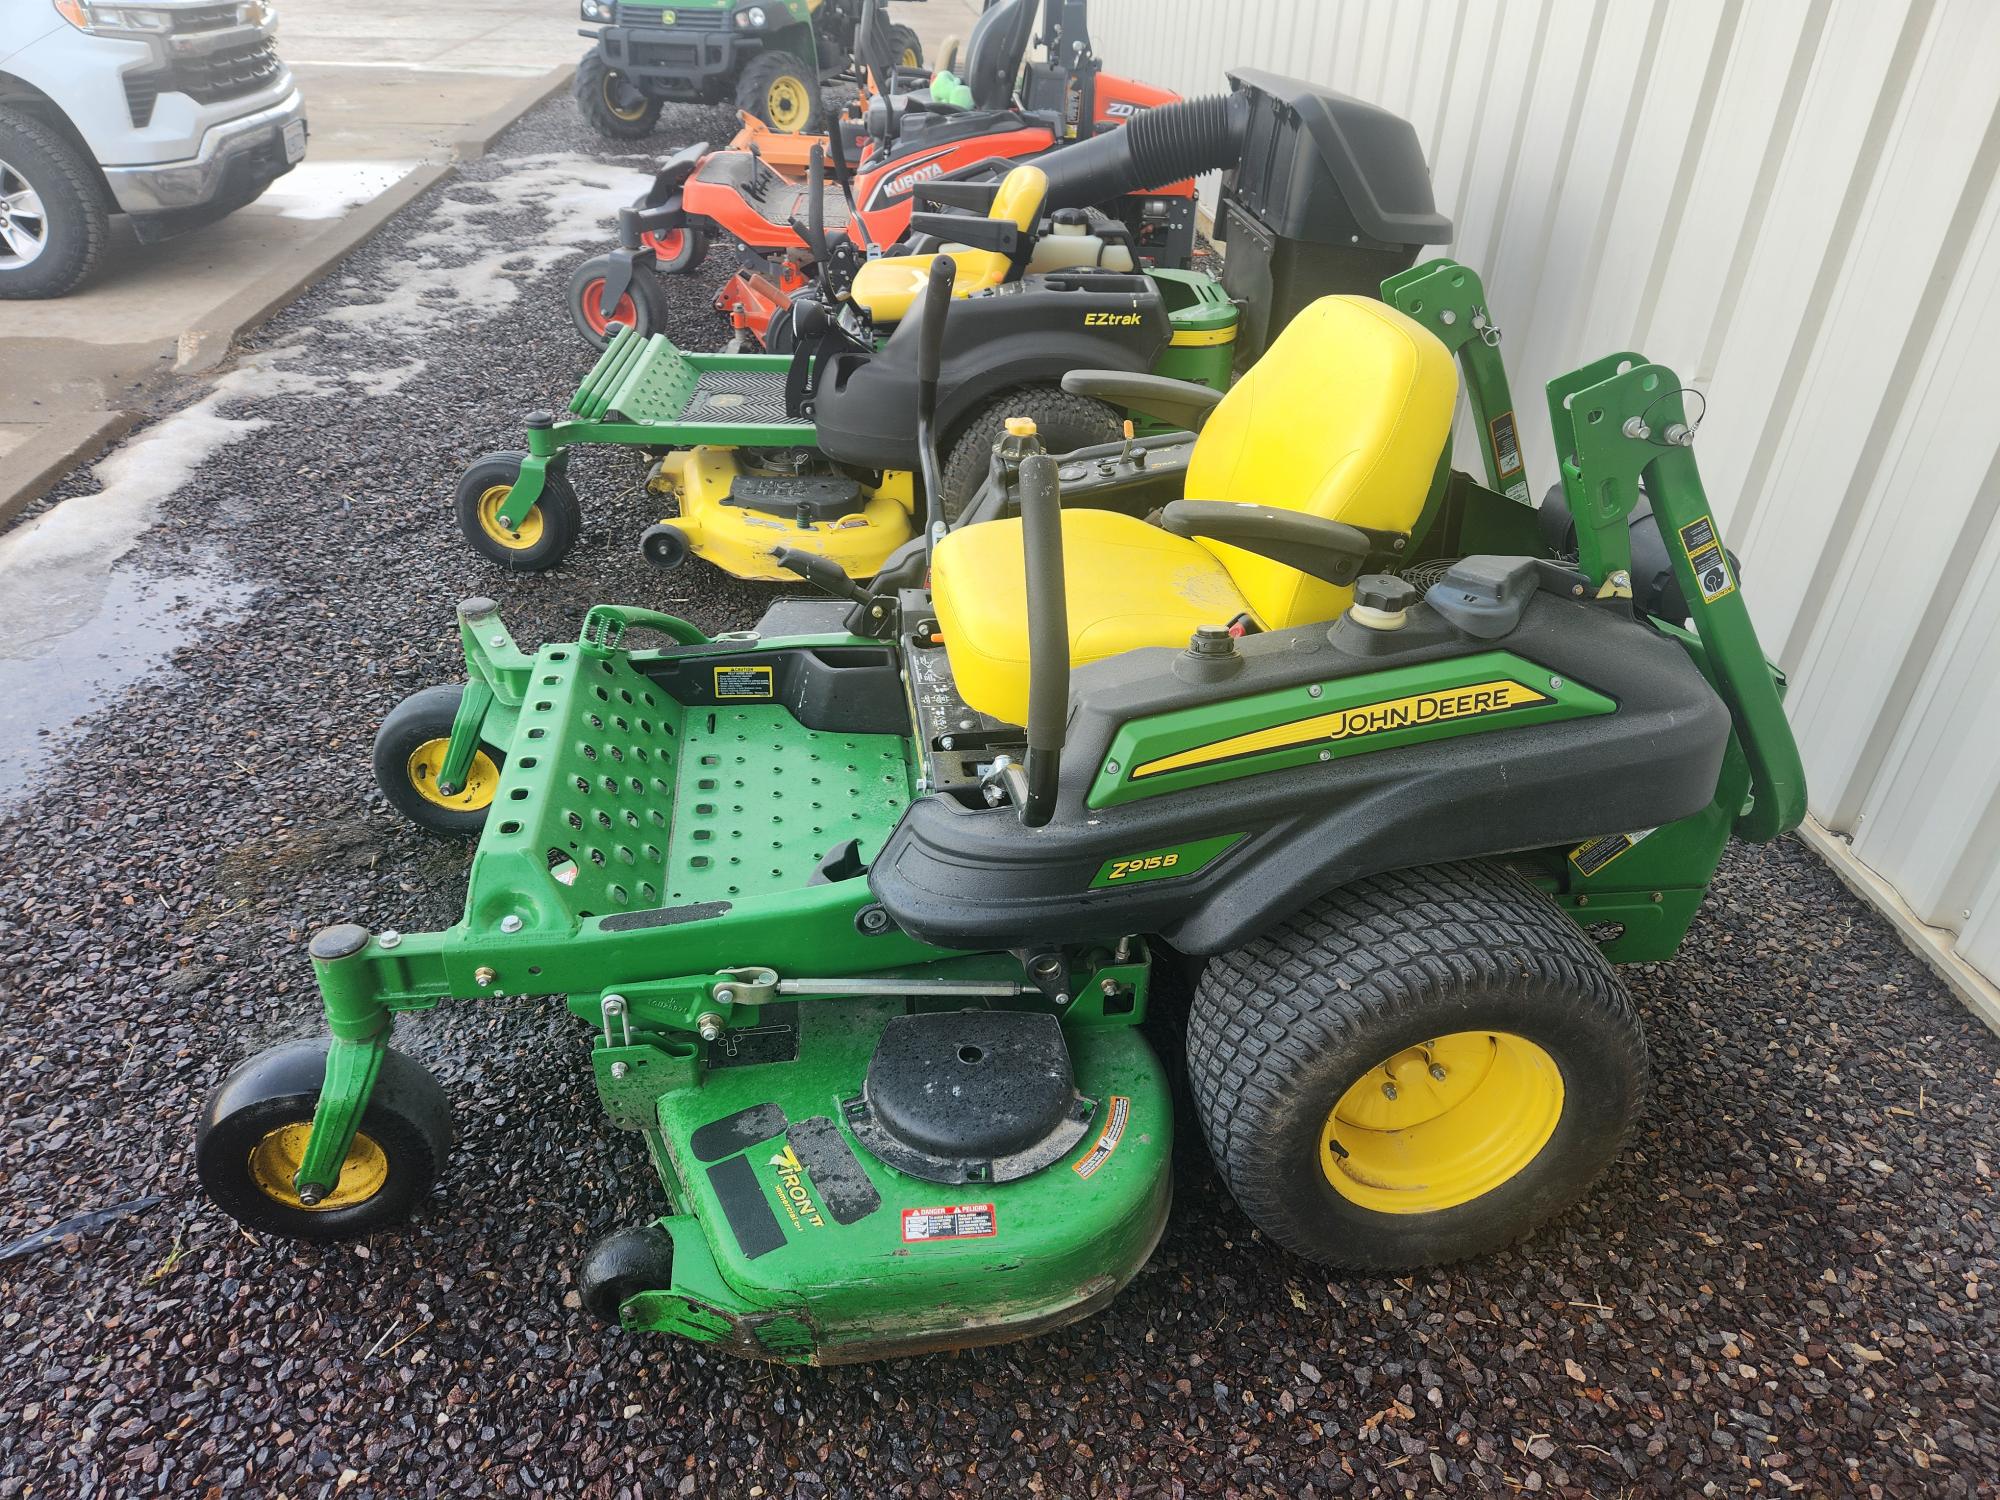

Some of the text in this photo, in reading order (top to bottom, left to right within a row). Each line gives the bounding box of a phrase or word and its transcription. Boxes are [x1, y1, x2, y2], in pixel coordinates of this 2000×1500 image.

[1105, 103, 1145, 117] ZD
[883, 163, 944, 197] KUBOTA
[1084, 313, 1142, 325] EZtrak
[1331, 688, 1511, 737] JOHN DEERE
[1108, 853, 1179, 879] Z915B
[962, 1204, 988, 1213] PELIGRO
